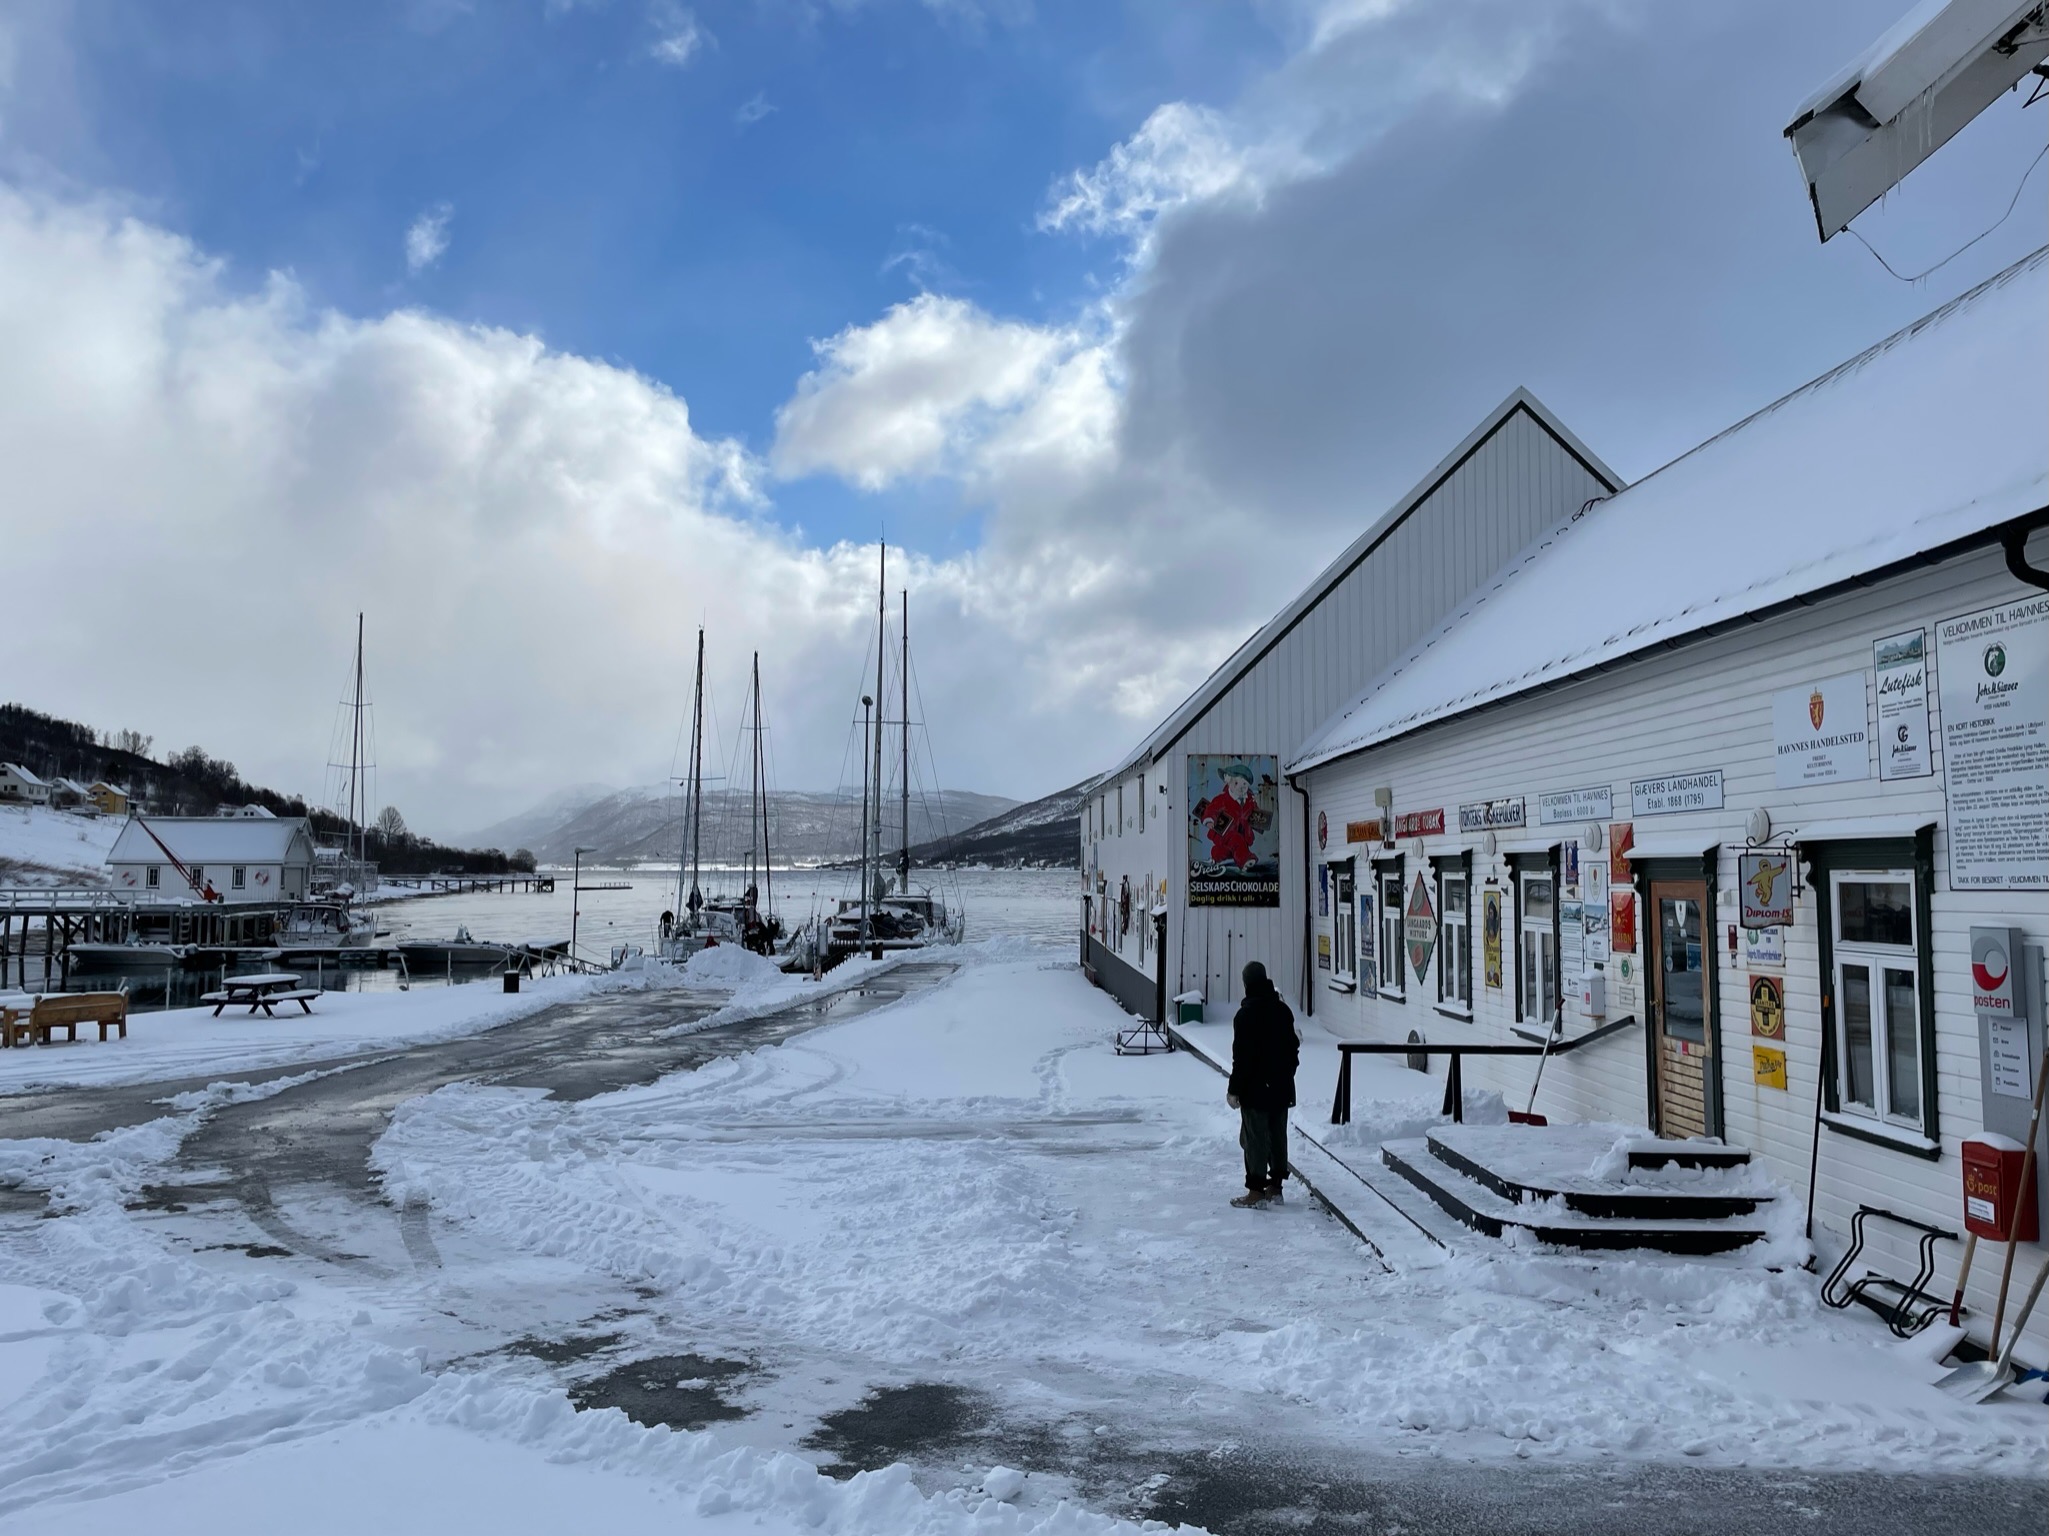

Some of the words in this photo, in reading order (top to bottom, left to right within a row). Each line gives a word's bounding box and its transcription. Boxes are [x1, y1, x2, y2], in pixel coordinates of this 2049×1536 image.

[1943, 615, 1992, 638] VELKOMMEN
[1995, 613, 2006, 625] TIL
[2009, 600, 2049, 622] HAVNNES
[1879, 668, 1923, 696] Lutefisk
[1948, 724, 1954, 732] EN
[1956, 722, 1968, 731] KORT
[1778, 741, 1809, 755] HAVNNES
[1810, 732, 1864, 750] HANDELSSTED
[1635, 781, 1665, 796] GIÆVERS
[1668, 775, 1718, 792] LANDHANDEL
[1542, 795, 1572, 807] VELKOMMEN
[1573, 793, 1581, 804] TIL
[1583, 789, 1608, 802] HAVNNES
[1647, 798, 1665, 809] Etabl.
[1668, 795, 1682, 807] 1868
[1685, 792, 1704, 807] (1795)
[1553, 808, 1572, 819] Boplass
[1577, 806, 1589, 816] 6000
[1590, 805, 1596, 815] år
[1422, 813, 1441, 830] TOBAK
[1971, 876, 1980, 884] FOR
[1191, 895, 1215, 904] Daglig
[1217, 894, 1237, 902] drikk
[1745, 905, 1790, 919] DIPLOM-IS
[1974, 994, 2010, 1009] posten
[1978, 1182, 1997, 1196] post
